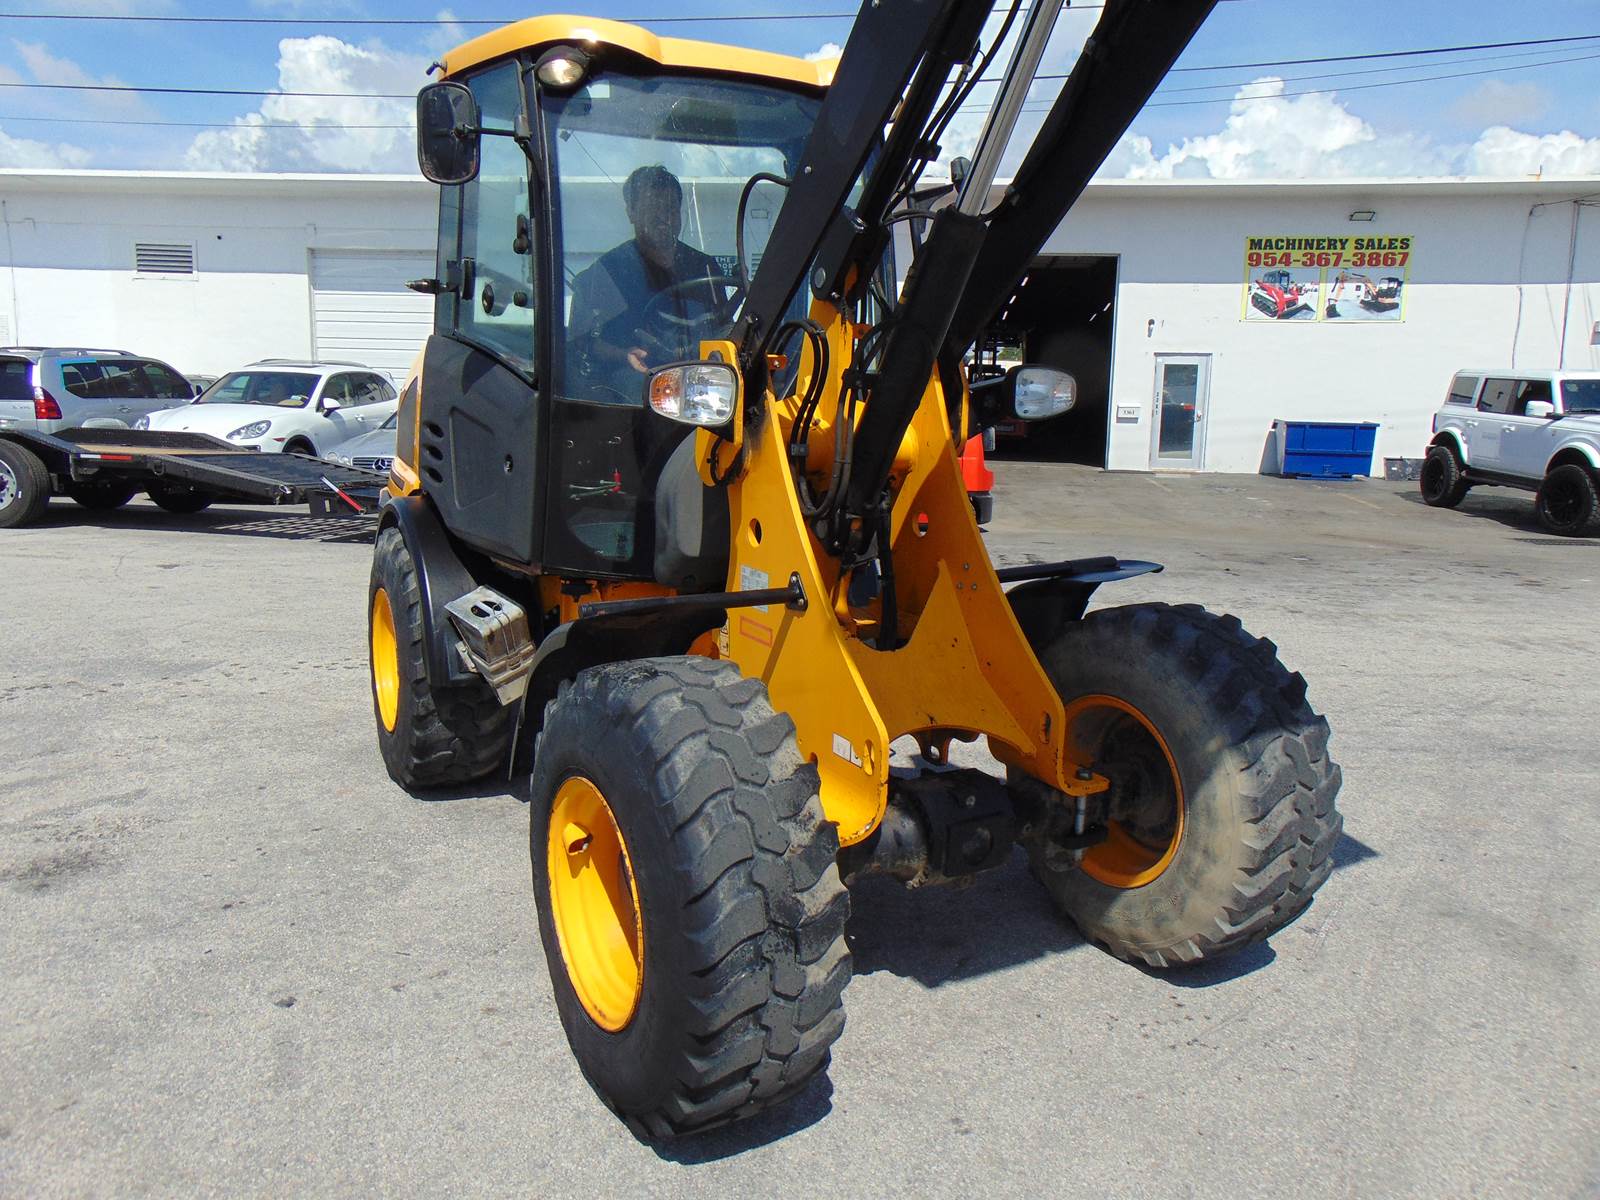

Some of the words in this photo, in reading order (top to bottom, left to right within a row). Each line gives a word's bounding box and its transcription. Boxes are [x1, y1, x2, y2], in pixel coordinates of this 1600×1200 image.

[1249, 238, 1349, 250] MACHINERY
[1354, 238, 1410, 250] SALES
[1248, 251, 1409, 267] 954-367-3867
